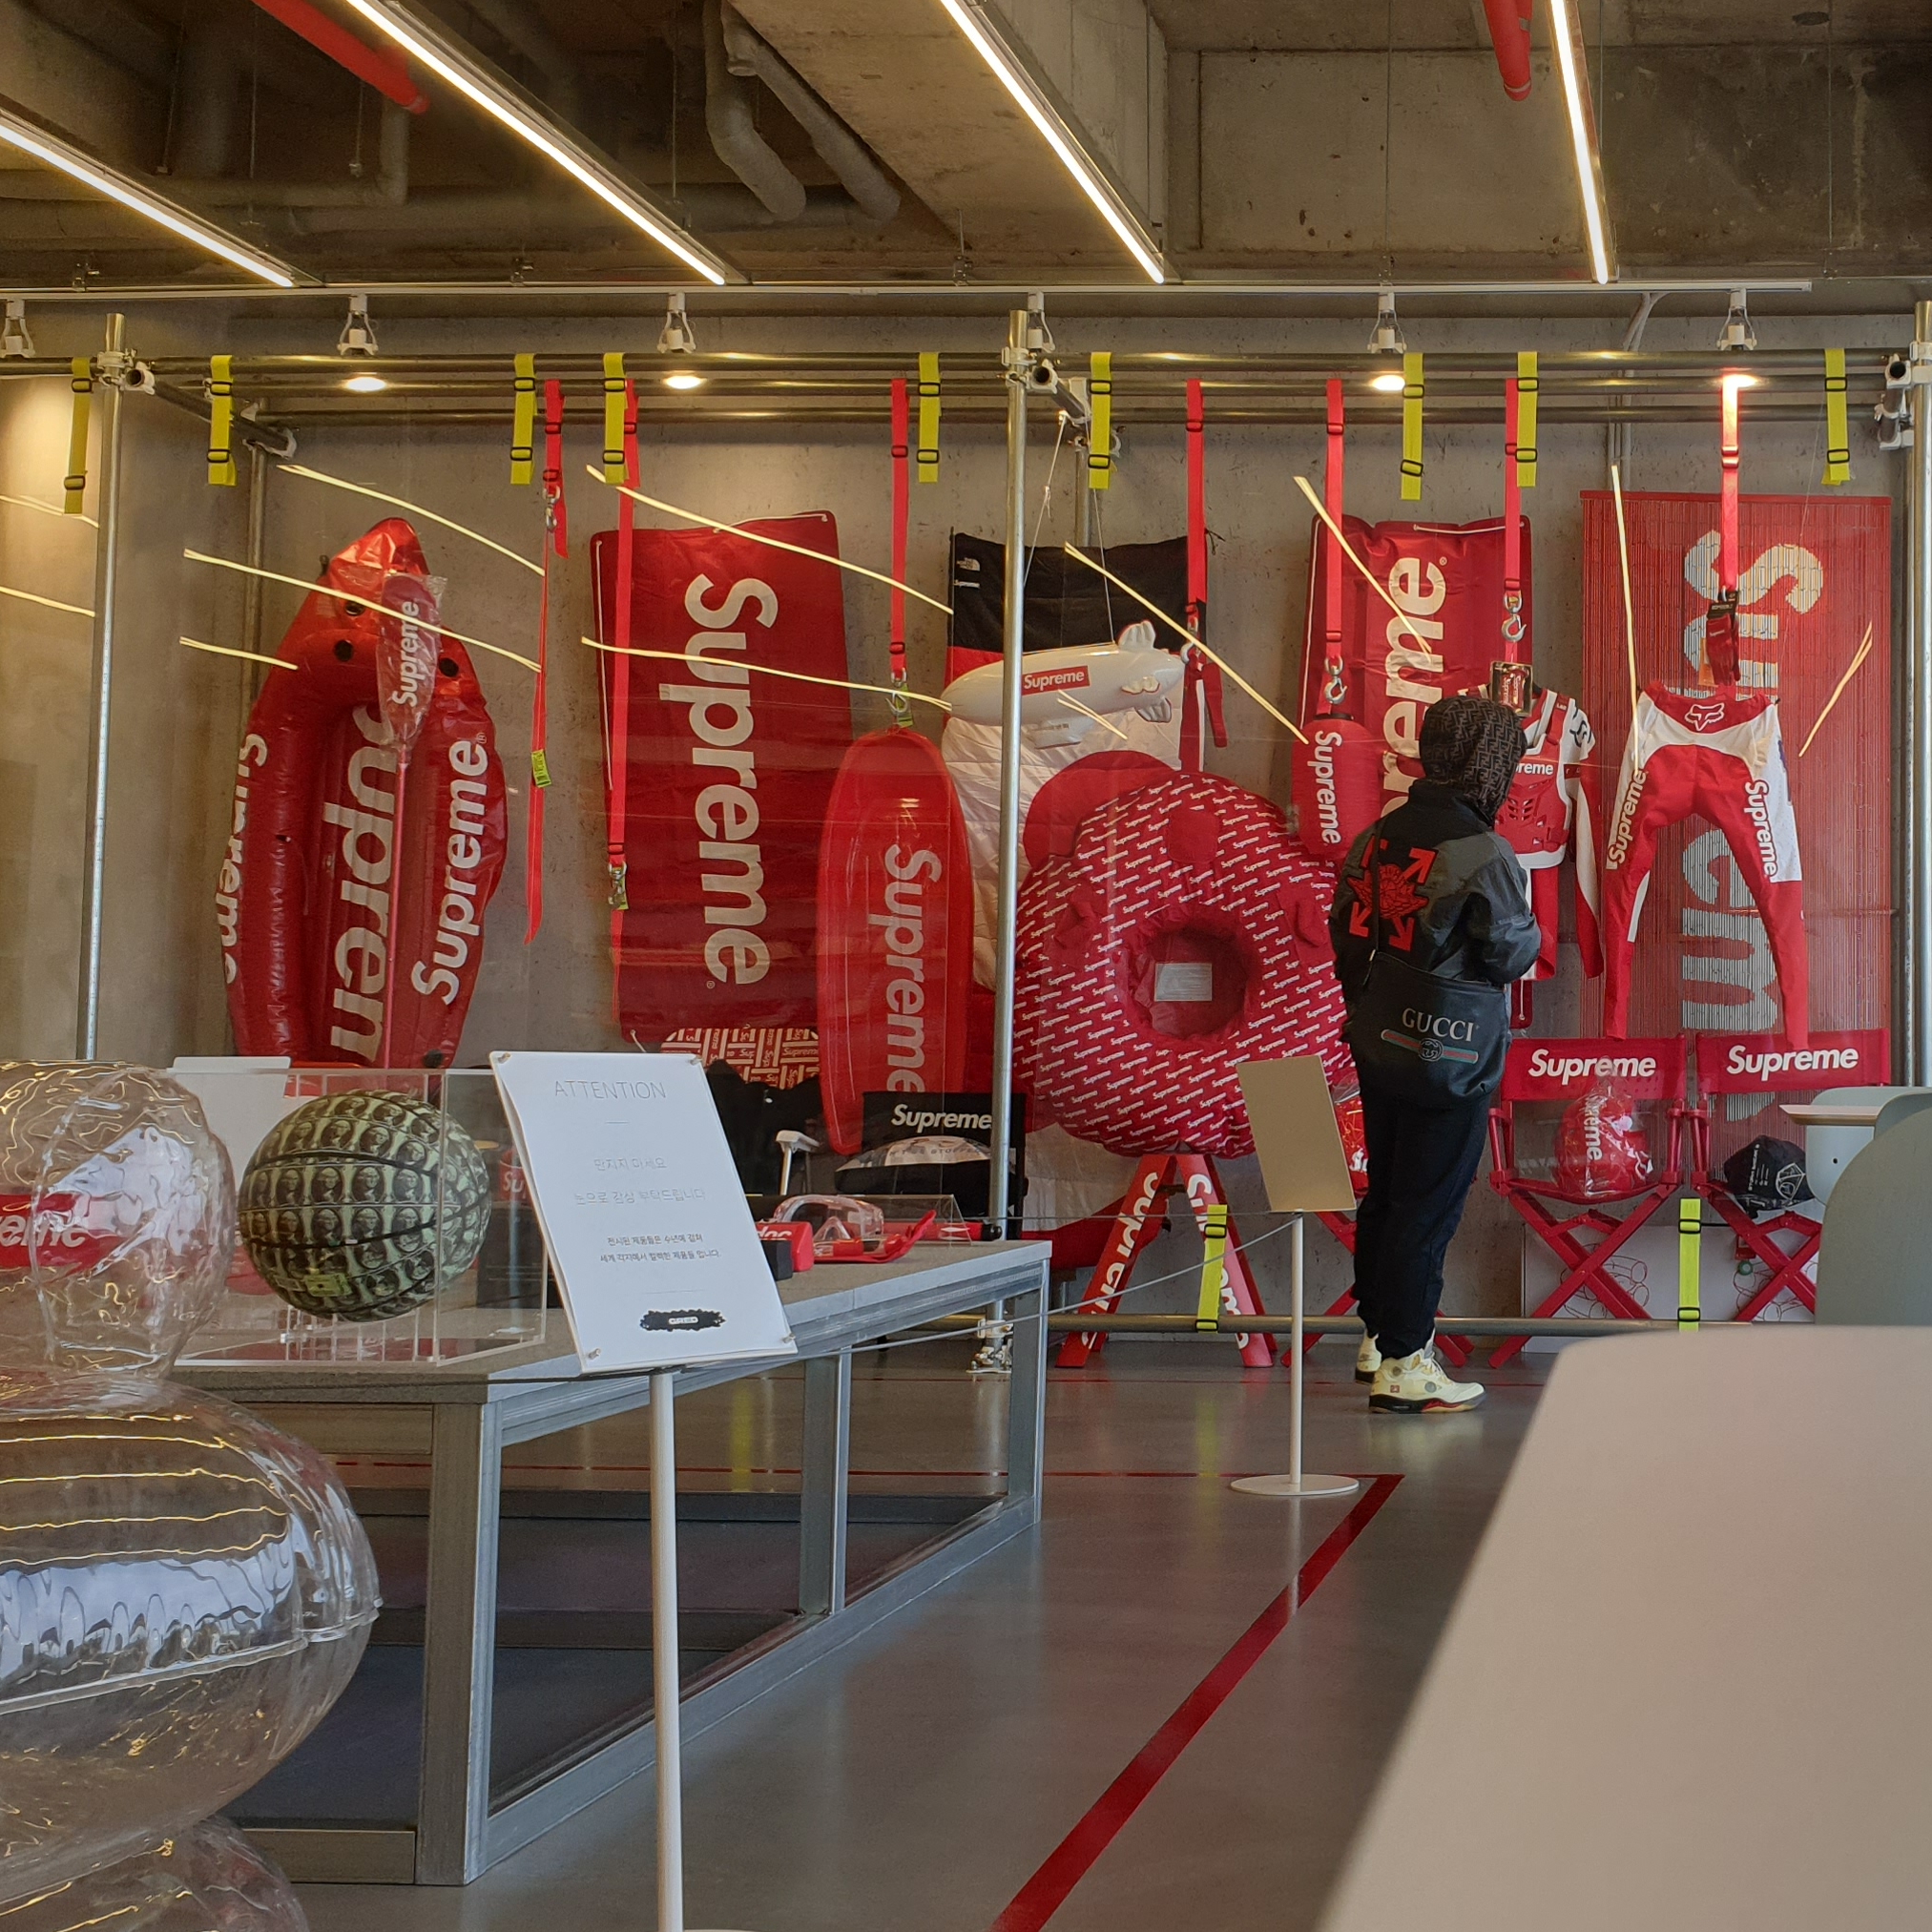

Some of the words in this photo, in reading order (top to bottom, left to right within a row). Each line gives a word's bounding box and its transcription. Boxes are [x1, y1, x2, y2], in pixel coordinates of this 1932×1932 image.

[392, 600, 419, 707] Supreme
[1024, 671, 1085, 692] Supreme
[658, 573, 779, 986] Supreme
[1306, 730, 1342, 844] Supreme
[1609, 770, 1648, 863] Supreme
[1743, 779, 1778, 878] Supreme
[411, 740, 488, 1005] Supreme
[1402, 1008, 1474, 1042] GUCCI
[1528, 1049, 1656, 1086] Supreme
[1727, 1045, 1859, 1081] Supreme
[554, 1080, 667, 1099] ATTENTION
[891, 1104, 992, 1133] Supreme
[593, 1157, 630, 1172] 만지지
[632, 1156, 668, 1170] 마세요
[574, 1192, 609, 1205] 눈으로
[613, 1191, 634, 1204] 감상
